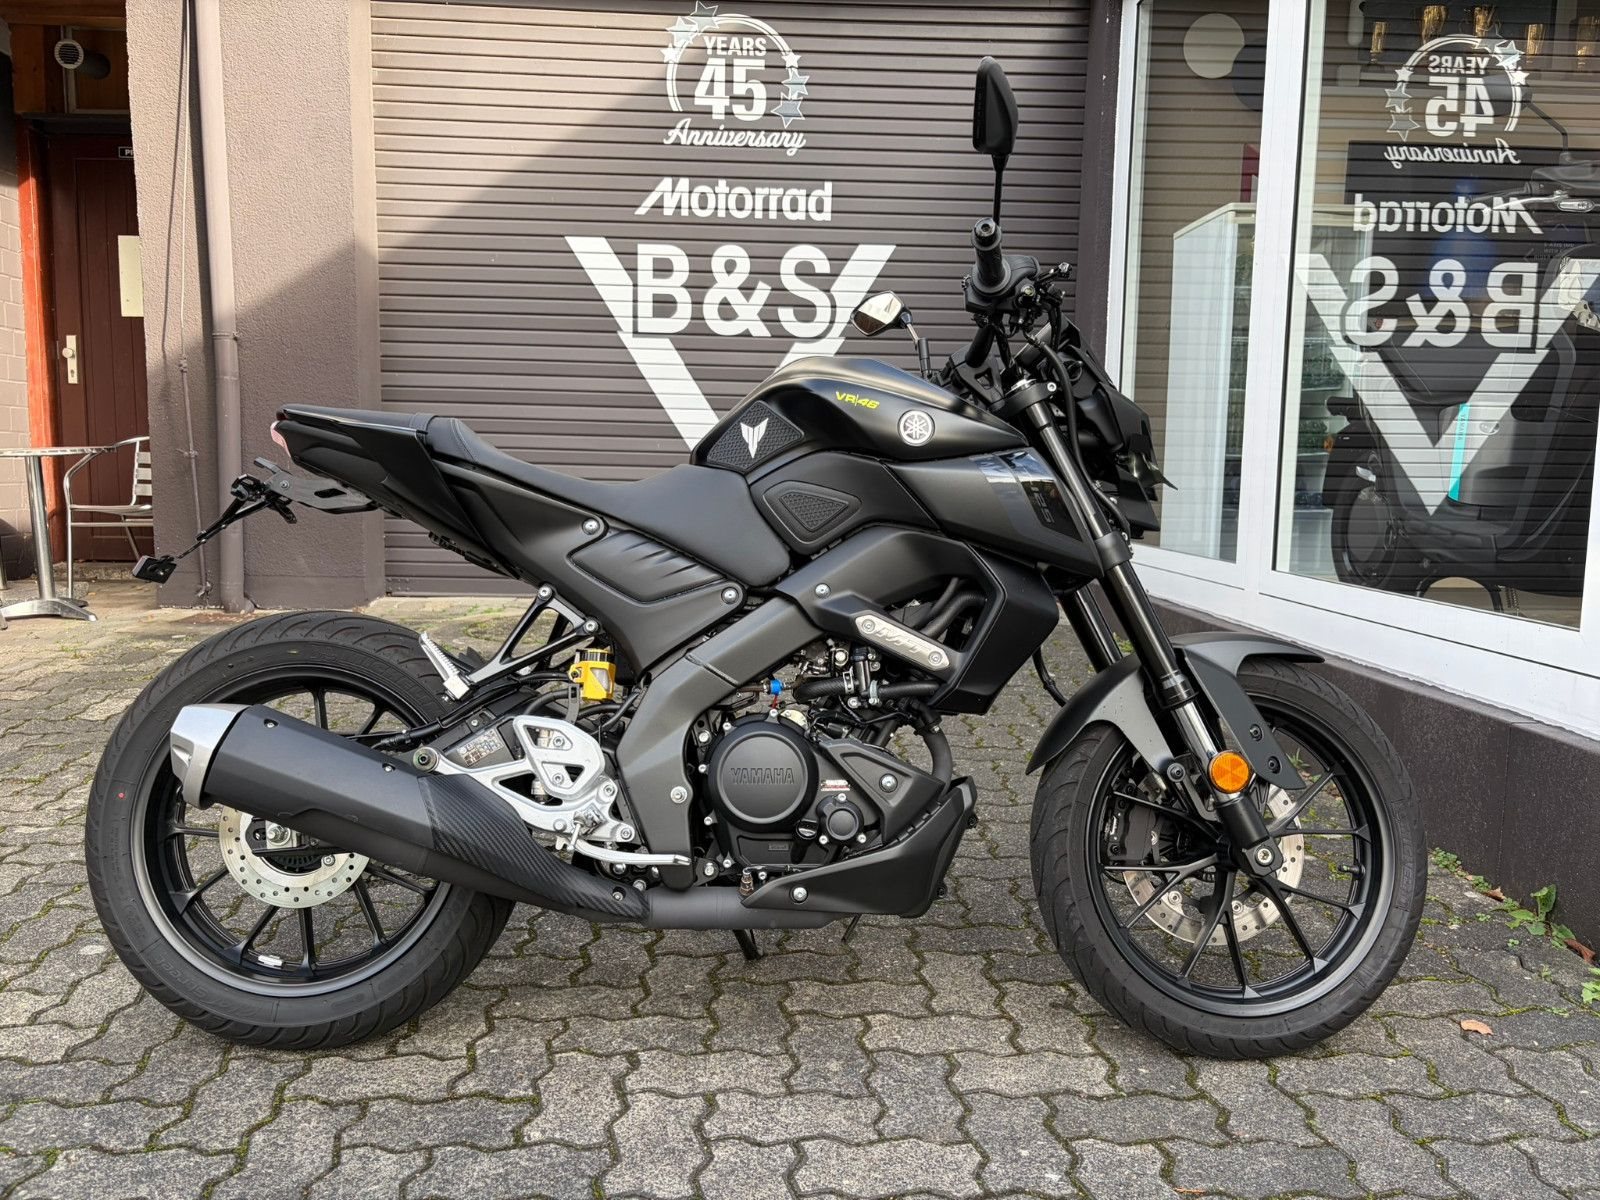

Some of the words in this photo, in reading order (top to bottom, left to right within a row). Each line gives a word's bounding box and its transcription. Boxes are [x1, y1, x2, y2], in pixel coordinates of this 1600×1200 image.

[703, 36, 767, 57] YEARS
[694, 57, 767, 121] 45
[663, 117, 807, 156] Anniversary
[634, 177, 833, 222] Motorrad
[637, 243, 833, 339] B&S
[731, 767, 795, 785] YAMAHA
